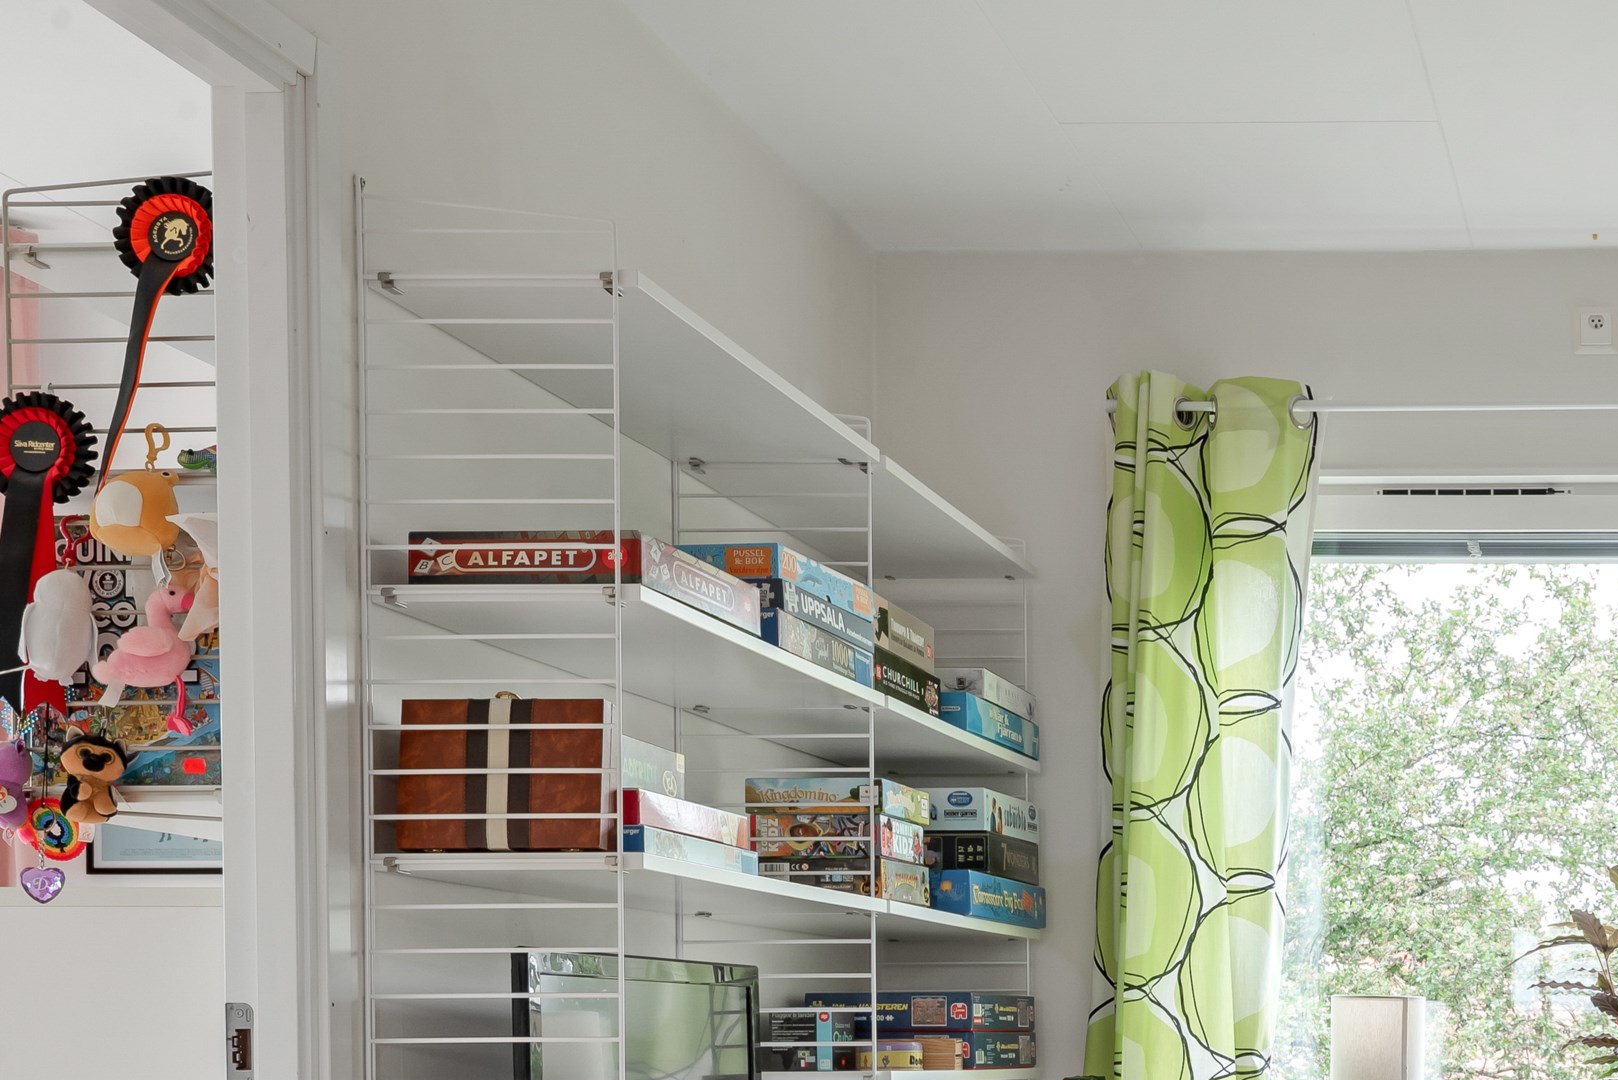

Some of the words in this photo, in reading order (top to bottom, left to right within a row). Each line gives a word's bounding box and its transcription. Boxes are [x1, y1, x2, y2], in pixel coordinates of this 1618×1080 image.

[467, 550, 578, 566] ALFAPET
[607, 550, 623, 561] ala
[733, 549, 766, 557] PUSSEL
[745, 557, 765, 565] BOK
[781, 551, 797, 573] 200
[680, 570, 728, 603] ALFAPET
[800, 592, 846, 633] UPPSALA
[831, 640, 849, 668] 1000
[882, 665, 920, 694] CHURCHILL
[760, 786, 838, 804] Kingdomino
[767, 818, 779, 852] KDZ
[858, 1003, 909, 1011] HASTEREN
